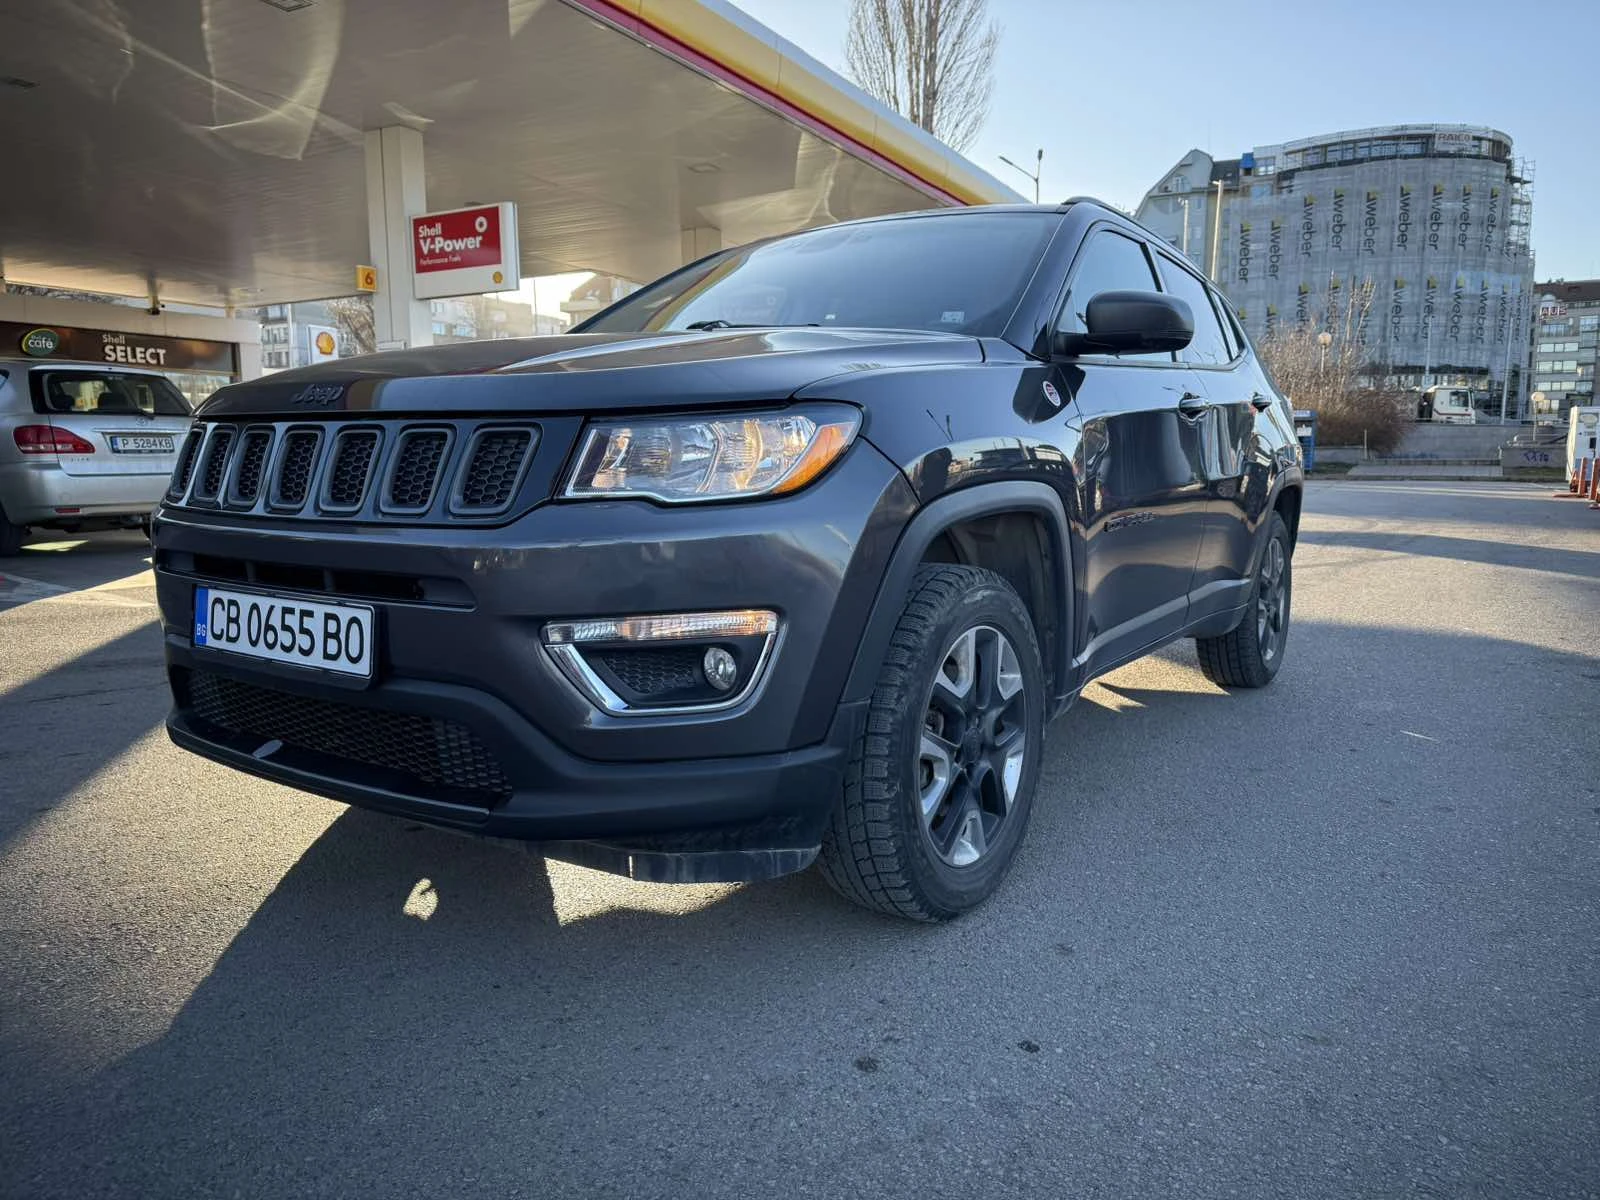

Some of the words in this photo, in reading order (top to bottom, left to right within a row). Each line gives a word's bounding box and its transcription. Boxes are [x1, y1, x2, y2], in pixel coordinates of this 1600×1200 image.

[418, 222, 442, 238] Shell
[420, 235, 482, 255] V-Power
[1301, 207, 1317, 258] weber
[1332, 198, 1346, 252] weber
[1364, 199, 1380, 256] weber
[1397, 196, 1412, 251] weber
[1429, 196, 1444, 251] weber
[1458, 196, 1471, 251] weber
[1484, 199, 1497, 252] weber
[365, 272, 373, 285] 6
[1239, 232, 1253, 285] weber
[1269, 229, 1283, 281] weber
[102, 334, 126, 345] Shell
[1392, 290, 1405, 342] weber
[1450, 290, 1463, 343] weber
[1476, 290, 1488, 344] weber
[28, 337, 53, 349] café
[104, 344, 167, 366] SELECT
[291, 384, 344, 406] Jeep
[121, 438, 129, 448] P
[196, 623, 207, 637] BG
[210, 597, 241, 643] CB
[247, 602, 315, 657] 0655
[323, 612, 364, 664] BO
